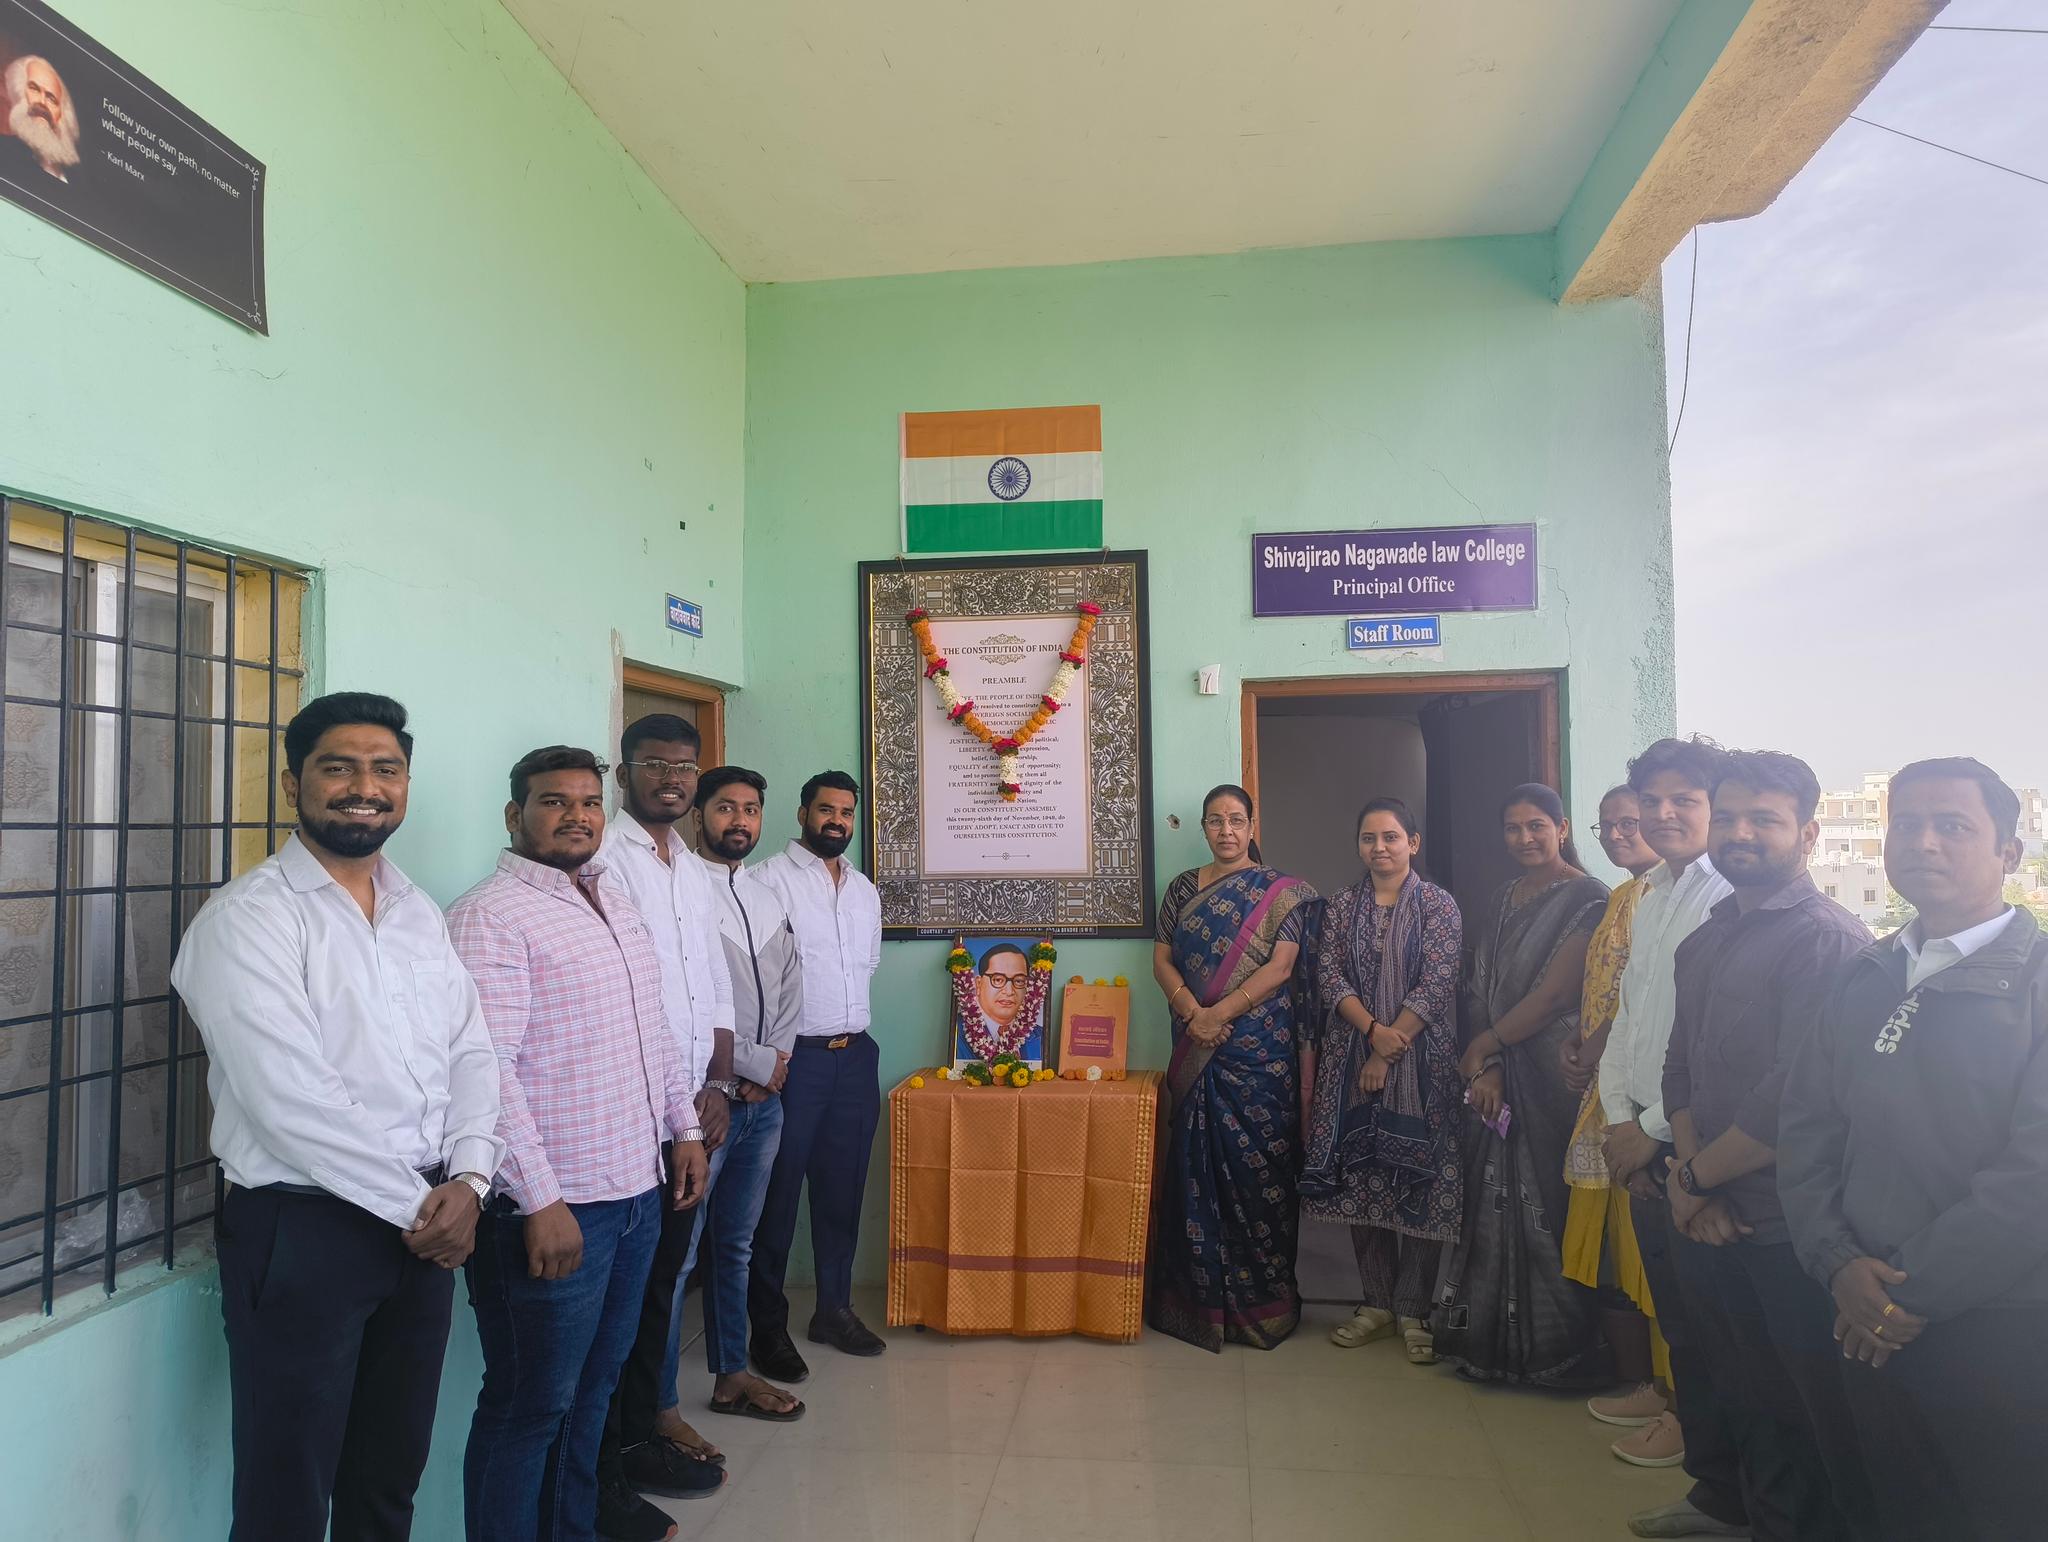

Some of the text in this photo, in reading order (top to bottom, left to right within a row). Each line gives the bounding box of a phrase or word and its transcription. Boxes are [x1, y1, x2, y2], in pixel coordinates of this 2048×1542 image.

[101, 118, 125, 141] what
[127, 135, 160, 163] people
[103, 97, 240, 199] Follow your own path, no matter
[107, 151, 123, 168] Karl
[125, 162, 145, 182] Marx
[1264, 538, 1526, 573] Shivajirao Nagawade law College
[1333, 576, 1456, 599] Principal Office
[1354, 623, 1434, 643] Staff Room
[943, 647, 960, 655] THE
[961, 644, 1024, 655] CONSTITUTION
[1039, 644, 1064, 652] INDIA
[982, 677, 1027, 685] PREAMBLE
[1875, 988, 1920, 1054] didas
